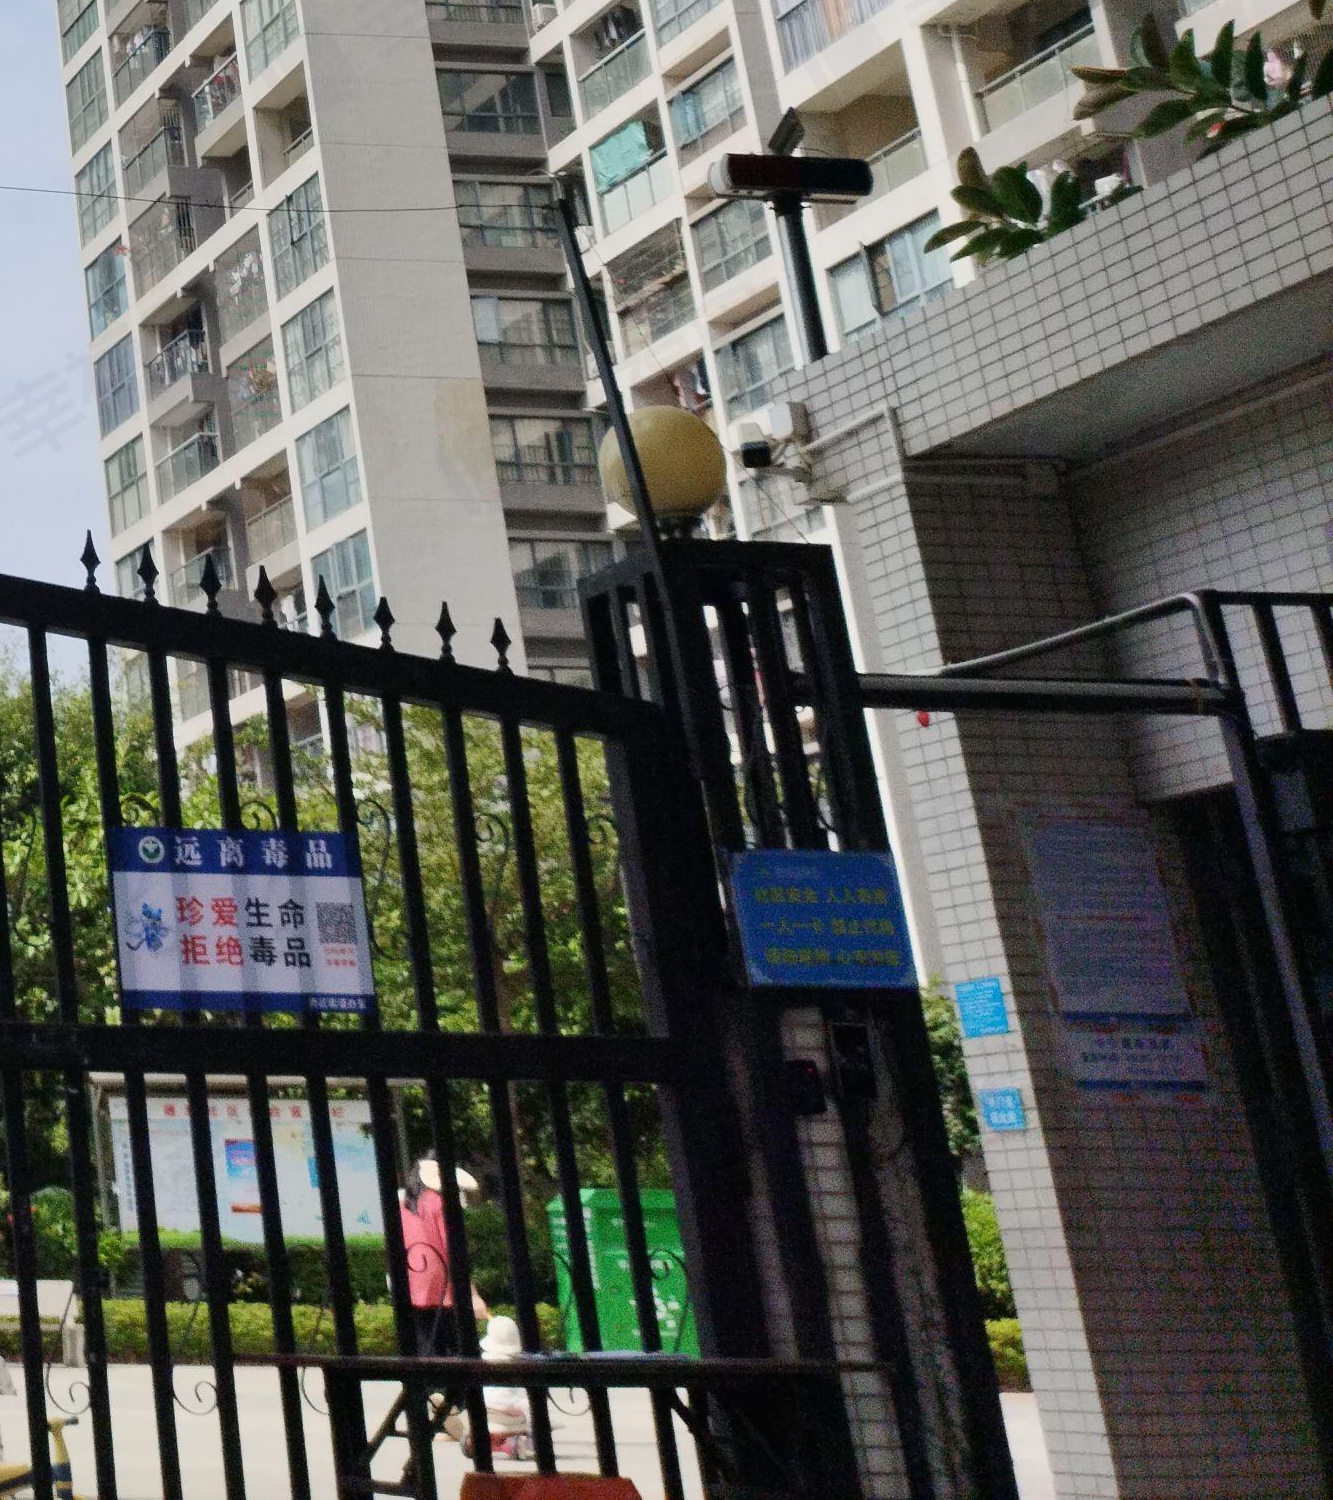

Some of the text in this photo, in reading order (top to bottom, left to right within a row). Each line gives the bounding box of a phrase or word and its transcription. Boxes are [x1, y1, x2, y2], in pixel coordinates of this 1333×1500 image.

[174, 836, 332, 869] 远离毒品
[176, 895, 305, 928] 珍爱生命
[180, 935, 311, 968] 拒绝毒品
